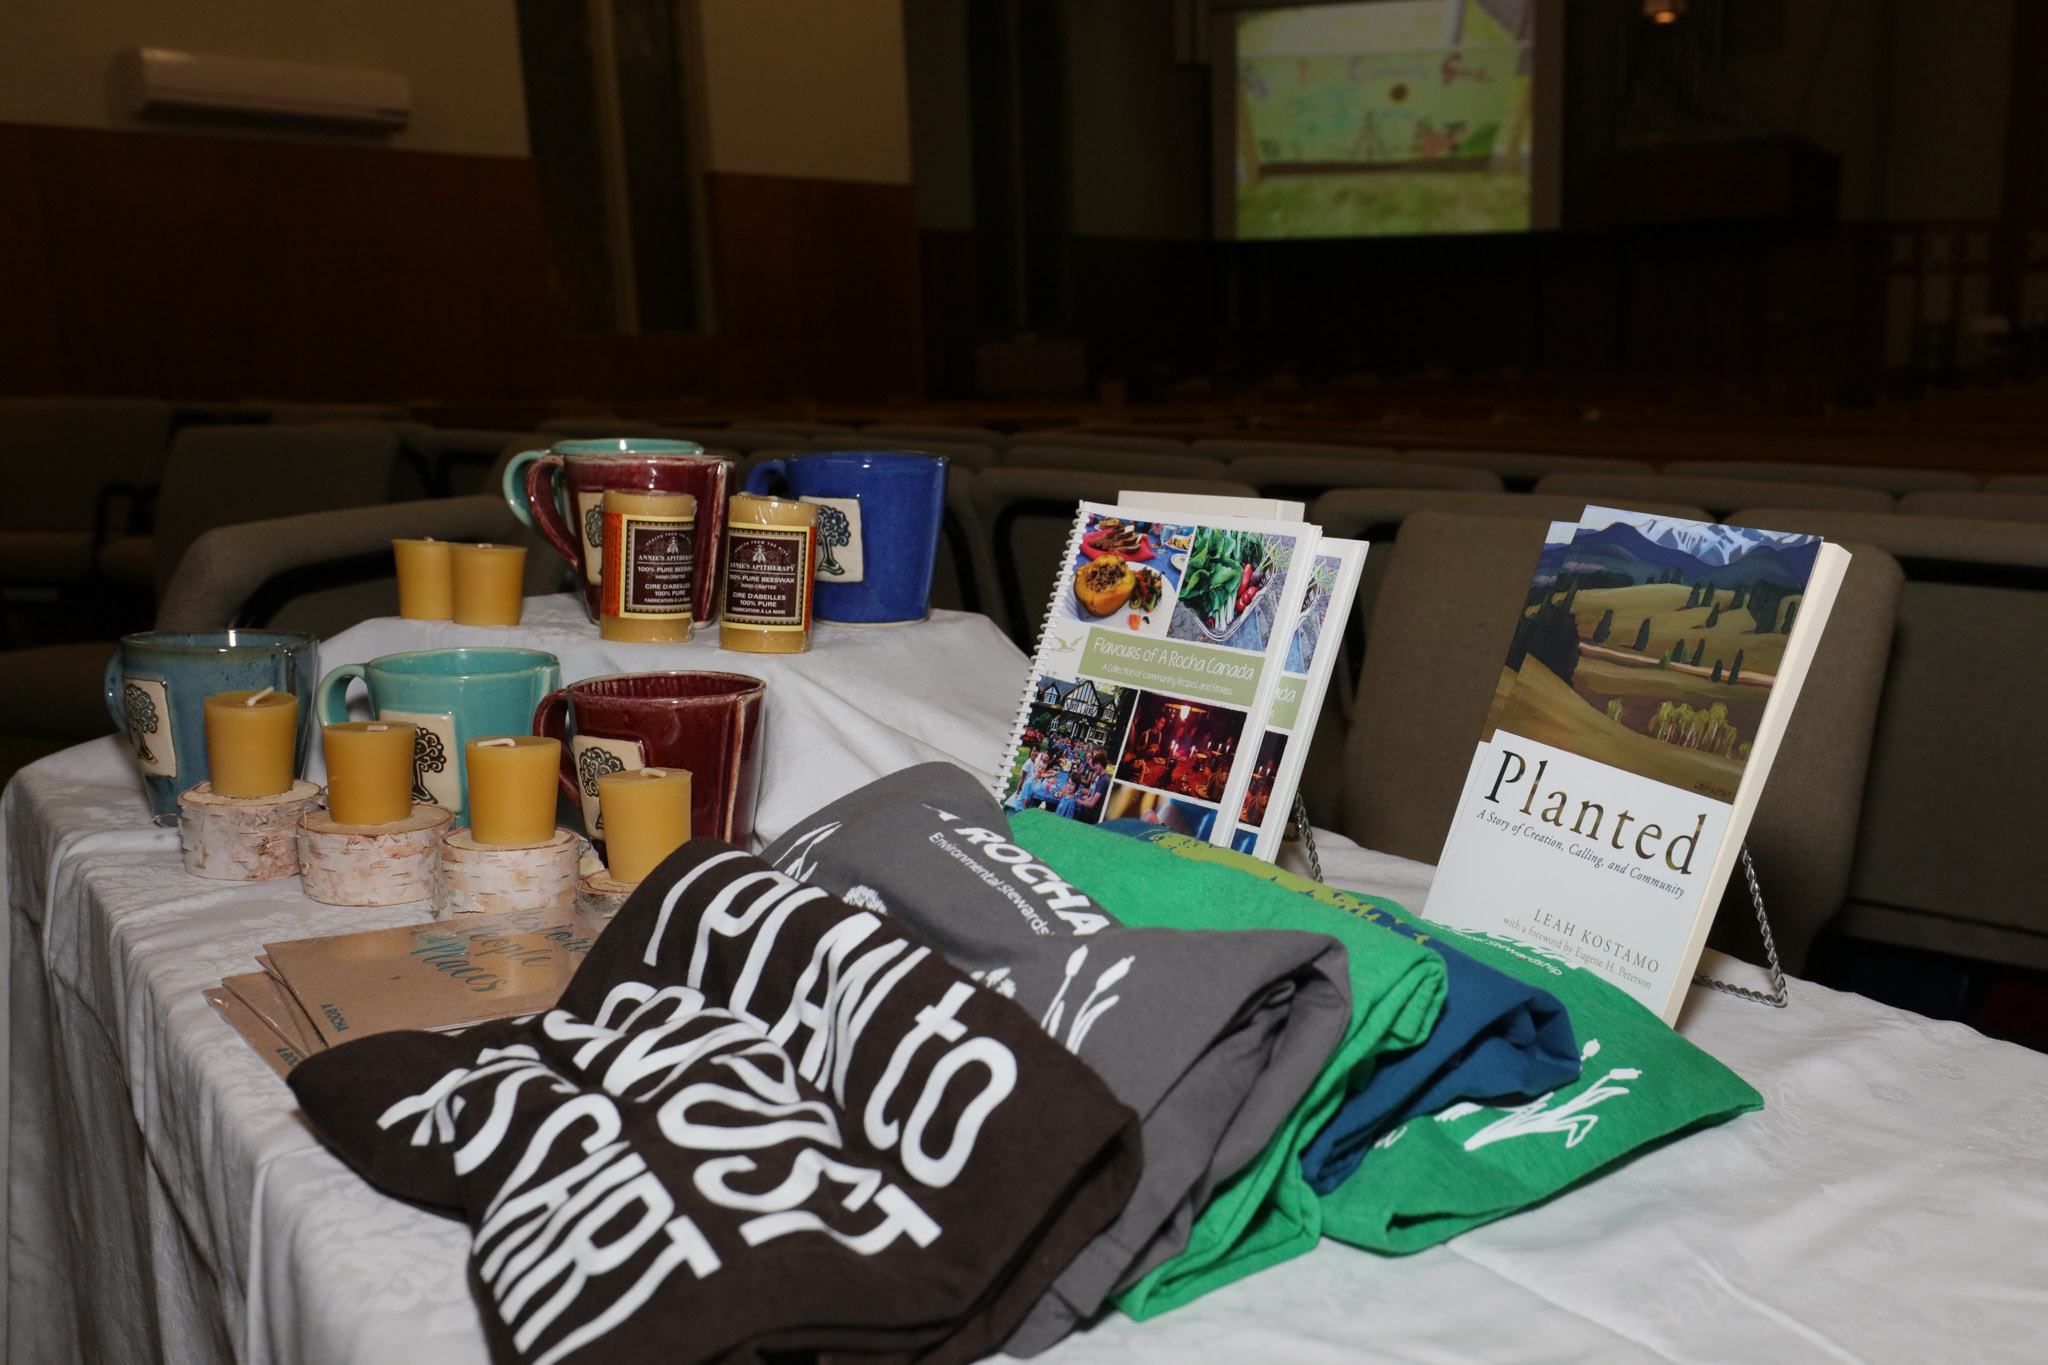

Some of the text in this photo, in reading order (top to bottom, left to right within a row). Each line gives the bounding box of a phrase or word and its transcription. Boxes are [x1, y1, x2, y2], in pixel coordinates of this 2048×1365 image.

[747, 593, 786, 601] D'ABEILLES
[752, 563, 795, 572] APITHERAPY
[761, 576, 795, 584] BEESWAX
[732, 606, 759, 614] FABRICATION
[757, 600, 777, 608] PURE
[1143, 647, 1159, 663] of
[1158, 649, 1168, 665] A
[1168, 650, 1206, 673] Rocha
[1207, 657, 1255, 681] Canada
[1484, 749, 1708, 876] Planted
[928, 831, 1005, 891] Environmental
[953, 826, 1111, 936] ROCHA
[1476, 808, 1687, 900] A Story of Creation, Calling, and Community
[1503, 917, 1521, 931] with
[1527, 926, 1563, 949] foreword
[1563, 941, 1574, 955] by
[1574, 946, 1604, 968] Eugene
[1604, 960, 1616, 974] H.
[1617, 965, 1652, 990] Peterson
[1533, 908, 1576, 937] LEAH
[1581, 929, 1660, 974] KOSTAMO
[642, 850, 755, 967] I
[863, 980, 1018, 1188] to
